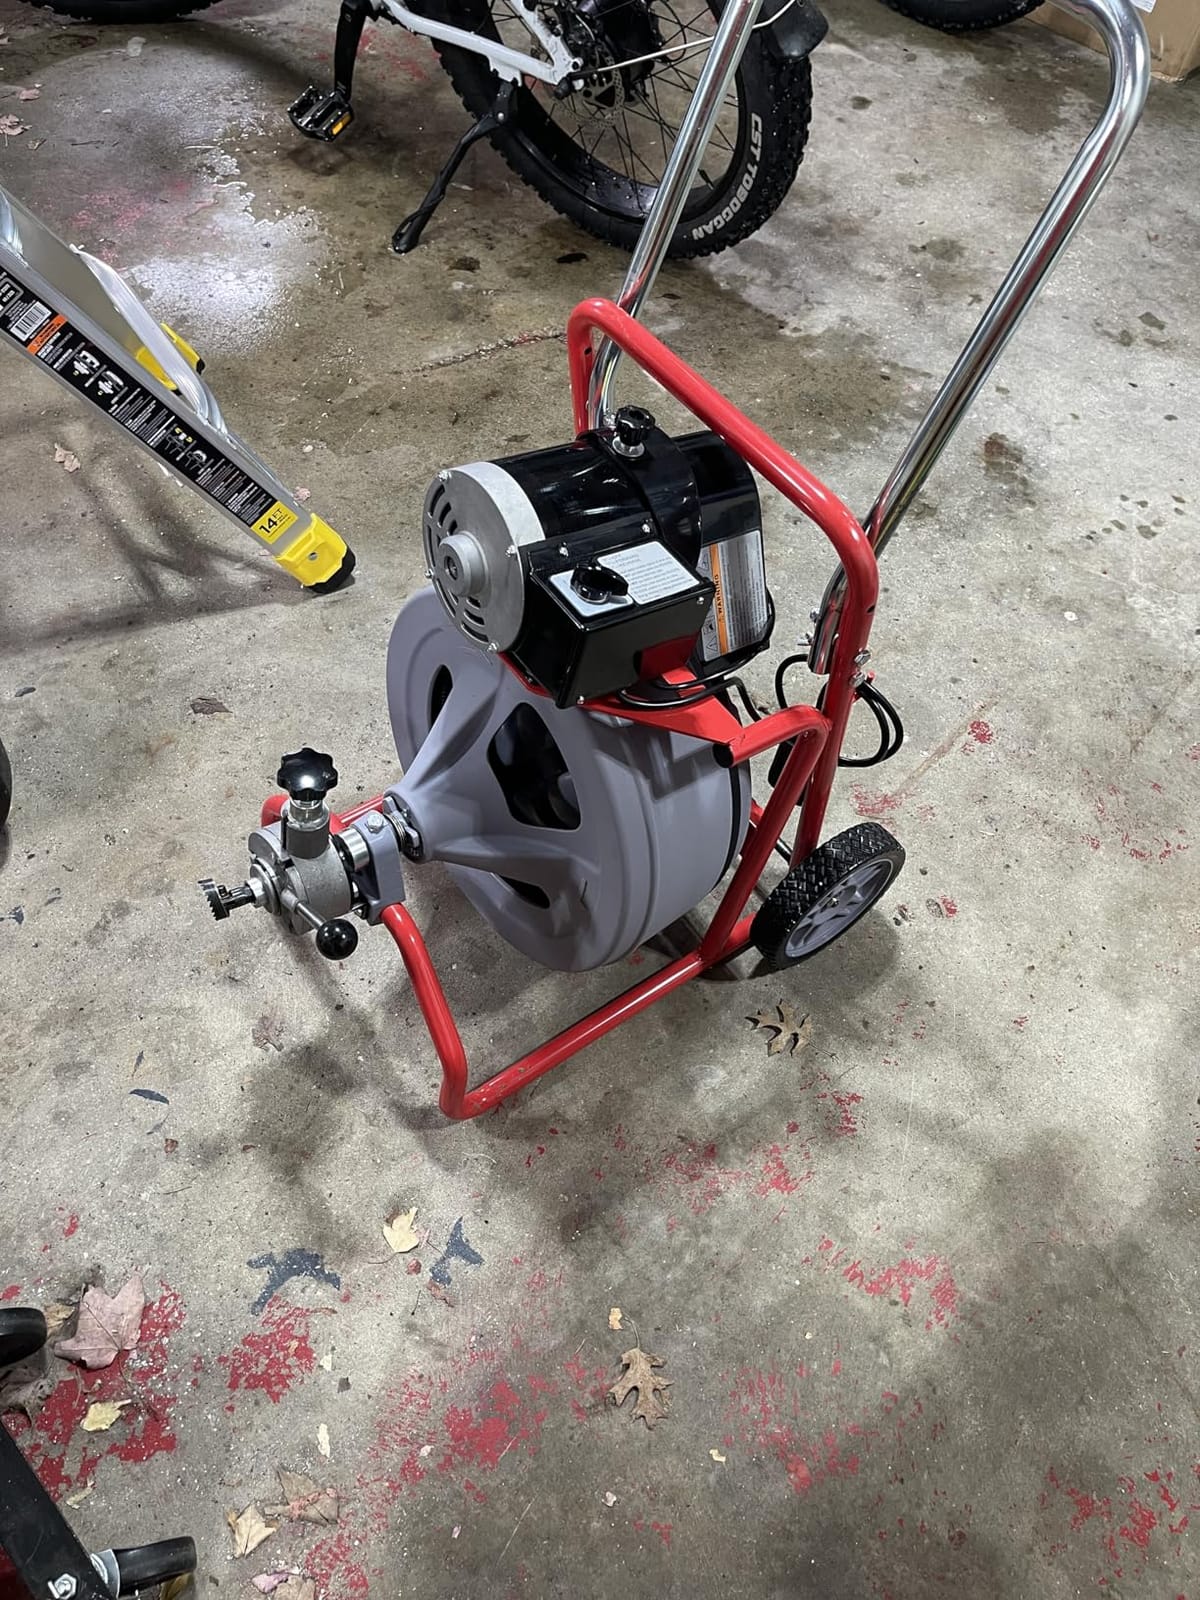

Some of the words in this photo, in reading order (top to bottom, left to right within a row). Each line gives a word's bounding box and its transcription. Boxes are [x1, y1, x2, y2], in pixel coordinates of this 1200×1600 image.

[750, 112, 762, 161] CST
[692, 163, 758, 240] TOBOGGAN
[259, 517, 278, 533] 14
[714, 574, 723, 614] WARNING
